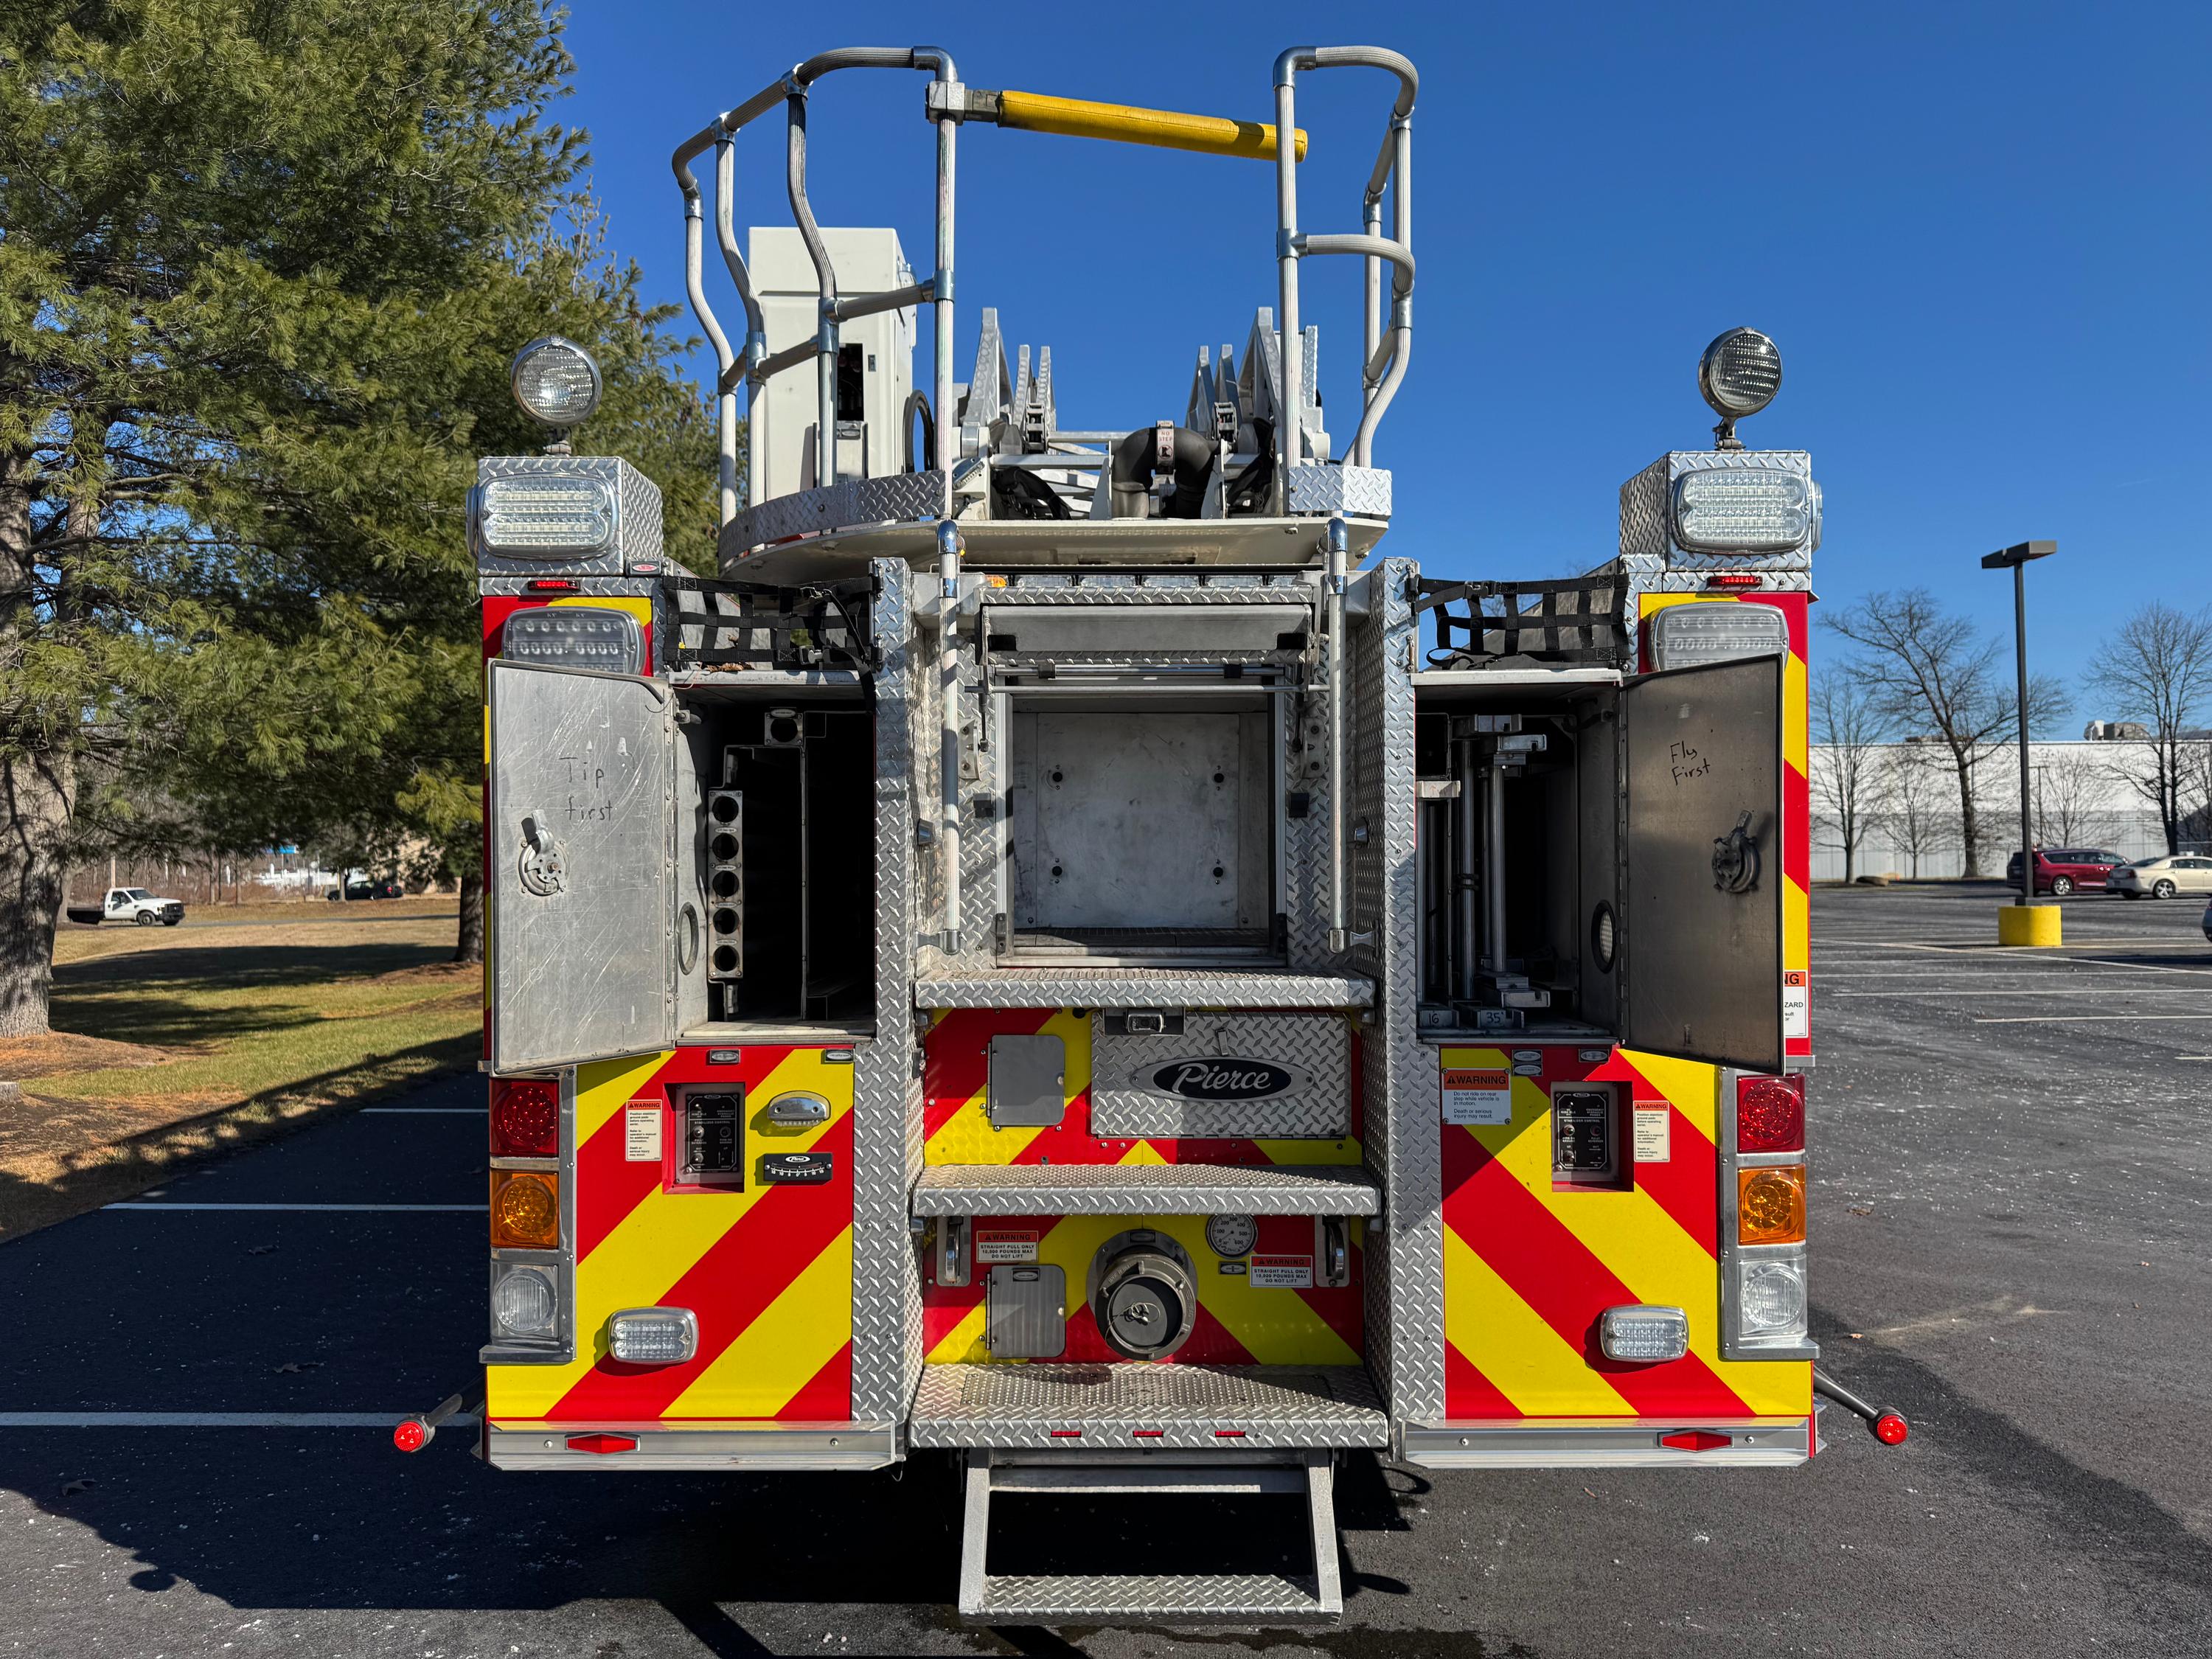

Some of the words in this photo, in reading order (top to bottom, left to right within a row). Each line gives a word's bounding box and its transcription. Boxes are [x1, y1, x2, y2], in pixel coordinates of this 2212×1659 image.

[1670, 740, 1697, 763] Fly
[558, 757, 605, 789] Tip
[1672, 758, 1711, 786] First
[565, 796, 613, 821] first
[1172, 1062, 1271, 1093] Pierce
[1456, 1076, 1506, 1085] WARNING
